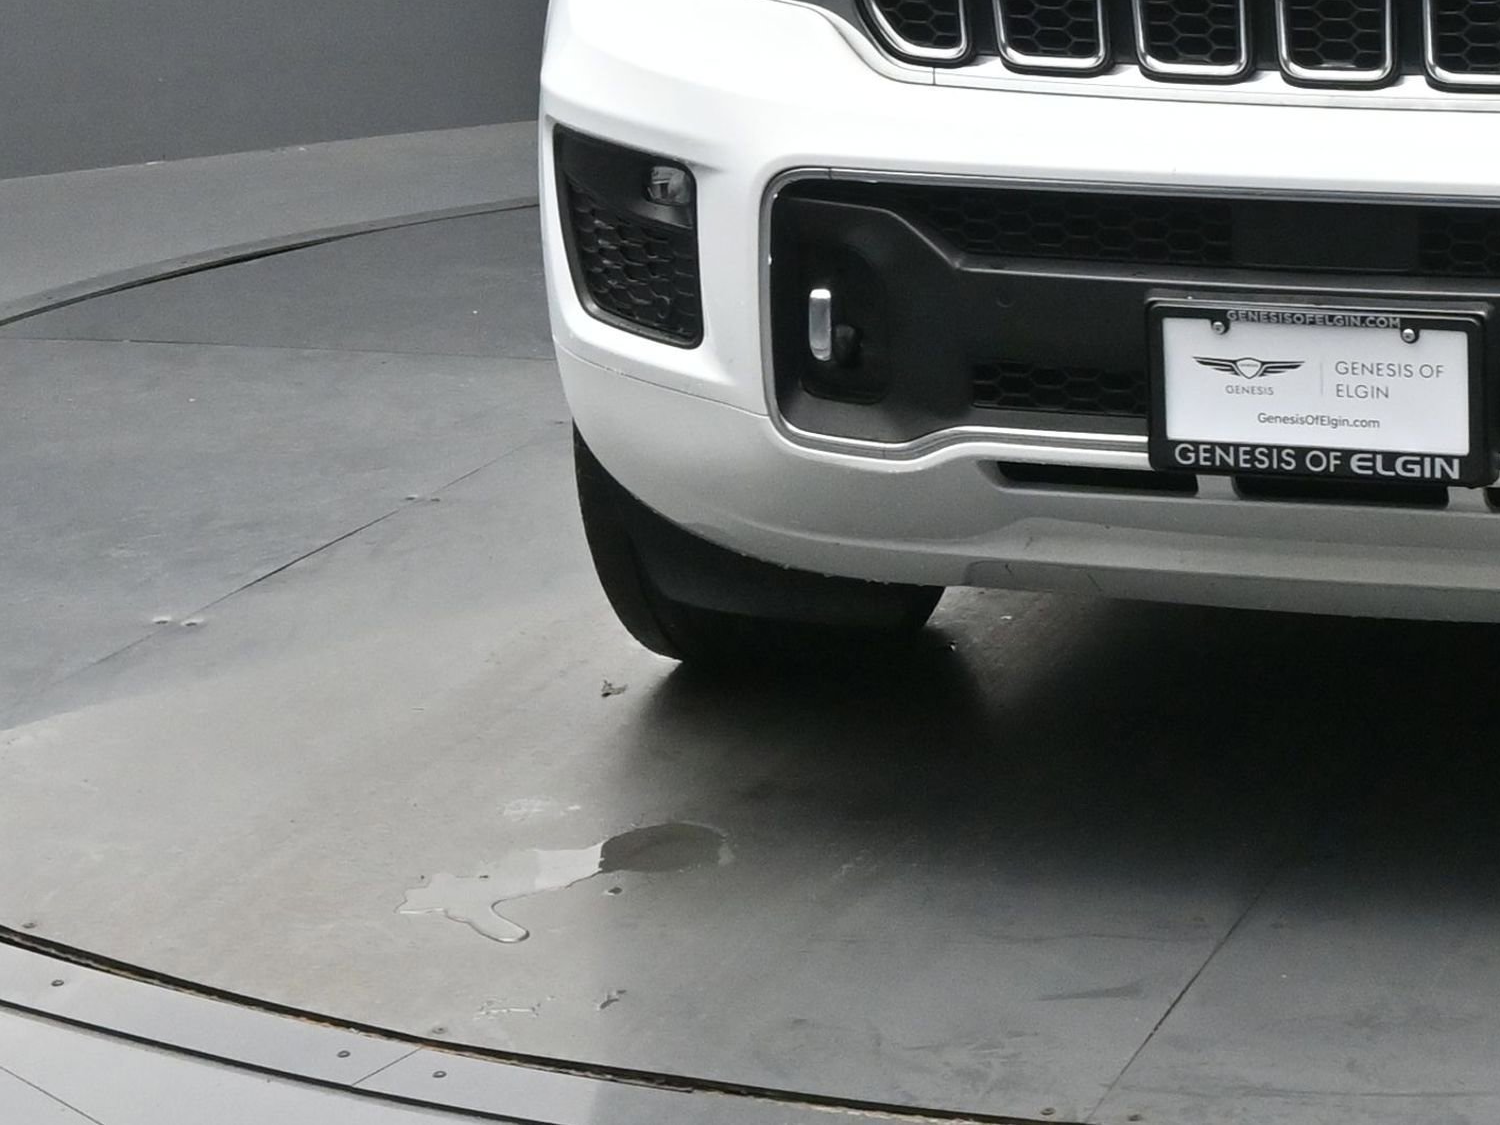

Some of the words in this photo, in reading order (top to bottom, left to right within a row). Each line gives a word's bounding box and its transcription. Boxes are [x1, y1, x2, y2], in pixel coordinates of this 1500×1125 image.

[1226, 309, 1401, 329] GENESISOFELGIN.COM
[1335, 360, 1413, 378] GENESIS
[1418, 363, 1445, 379] OF
[1224, 385, 1275, 396] GENESIS
[1335, 383, 1390, 400] ELGIN
[1257, 412, 1381, 430] GenesisOfElgin.com
[1174, 442, 1297, 471] GENESIS
[1305, 450, 1342, 473] OF
[1350, 452, 1461, 480] ELGIN
